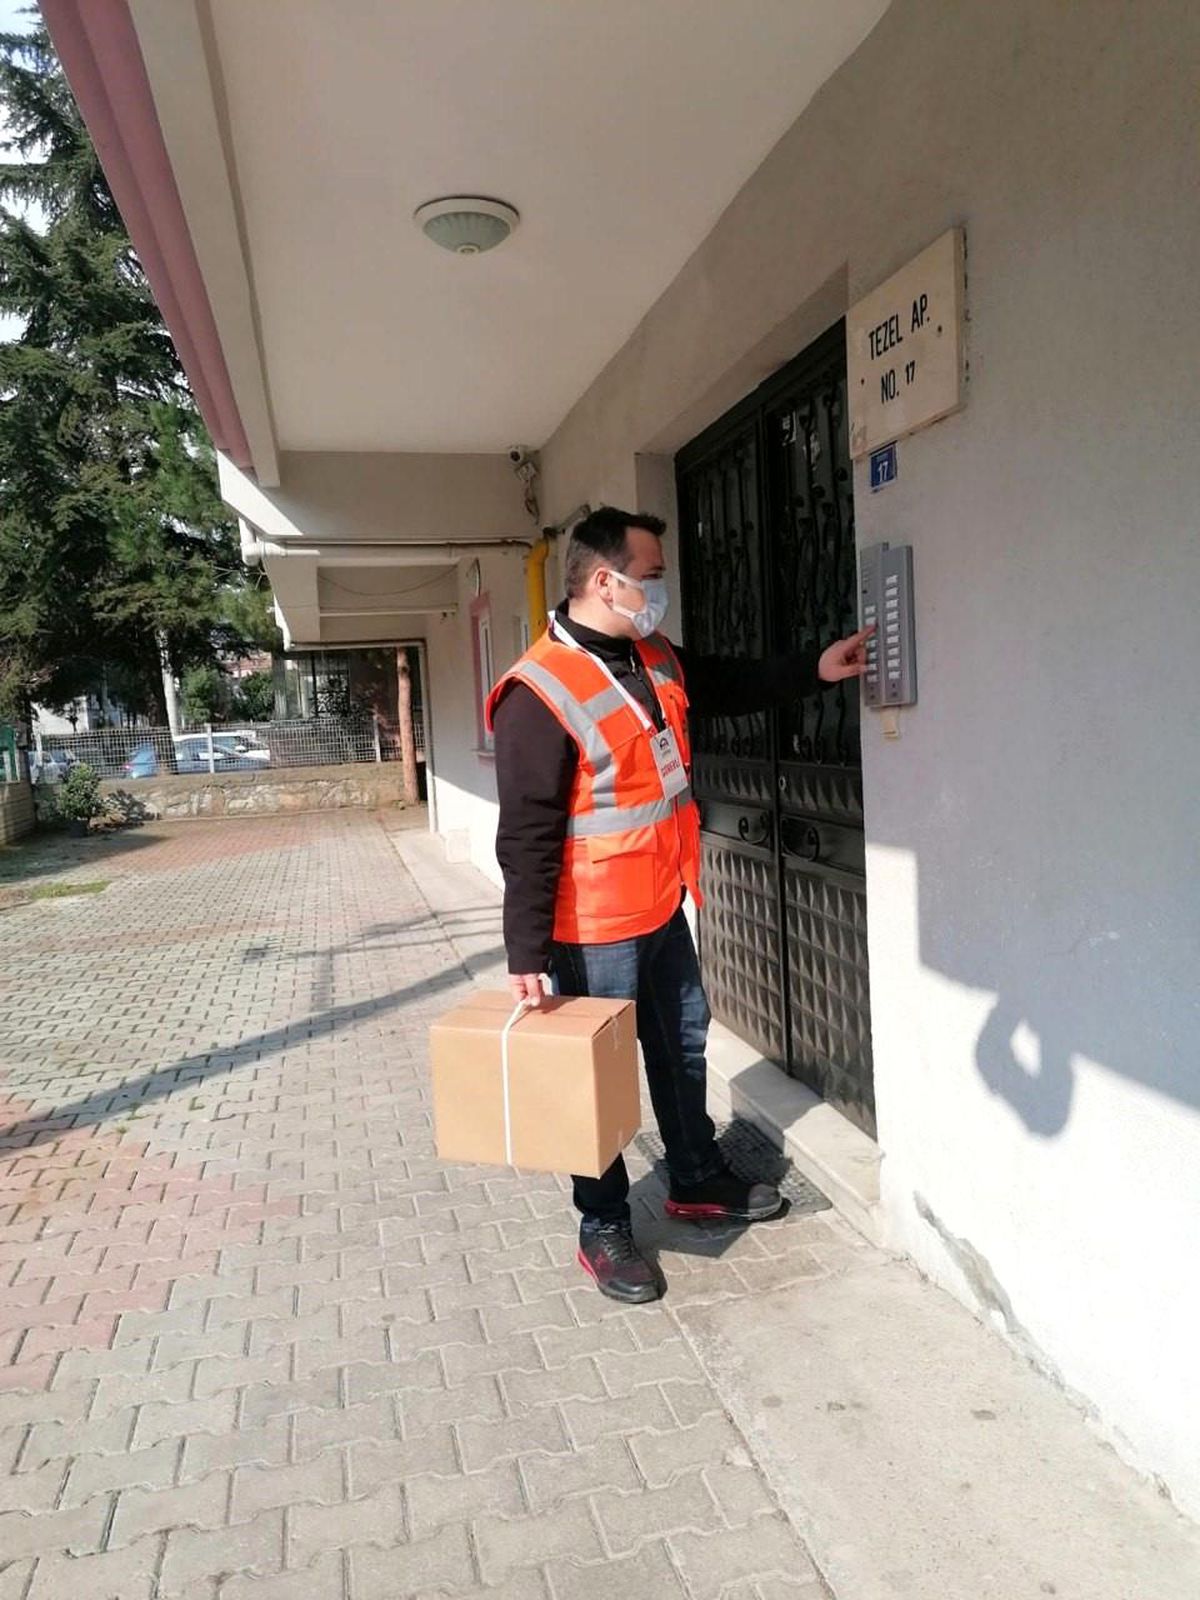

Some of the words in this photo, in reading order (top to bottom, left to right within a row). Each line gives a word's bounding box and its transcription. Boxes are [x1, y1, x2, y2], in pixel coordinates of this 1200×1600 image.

[868, 313, 903, 360] TEZEL
[911, 293, 930, 333] AP.
[881, 368, 899, 404] NO.
[905, 360, 915, 385] 17
[877, 461, 888, 482] 17
